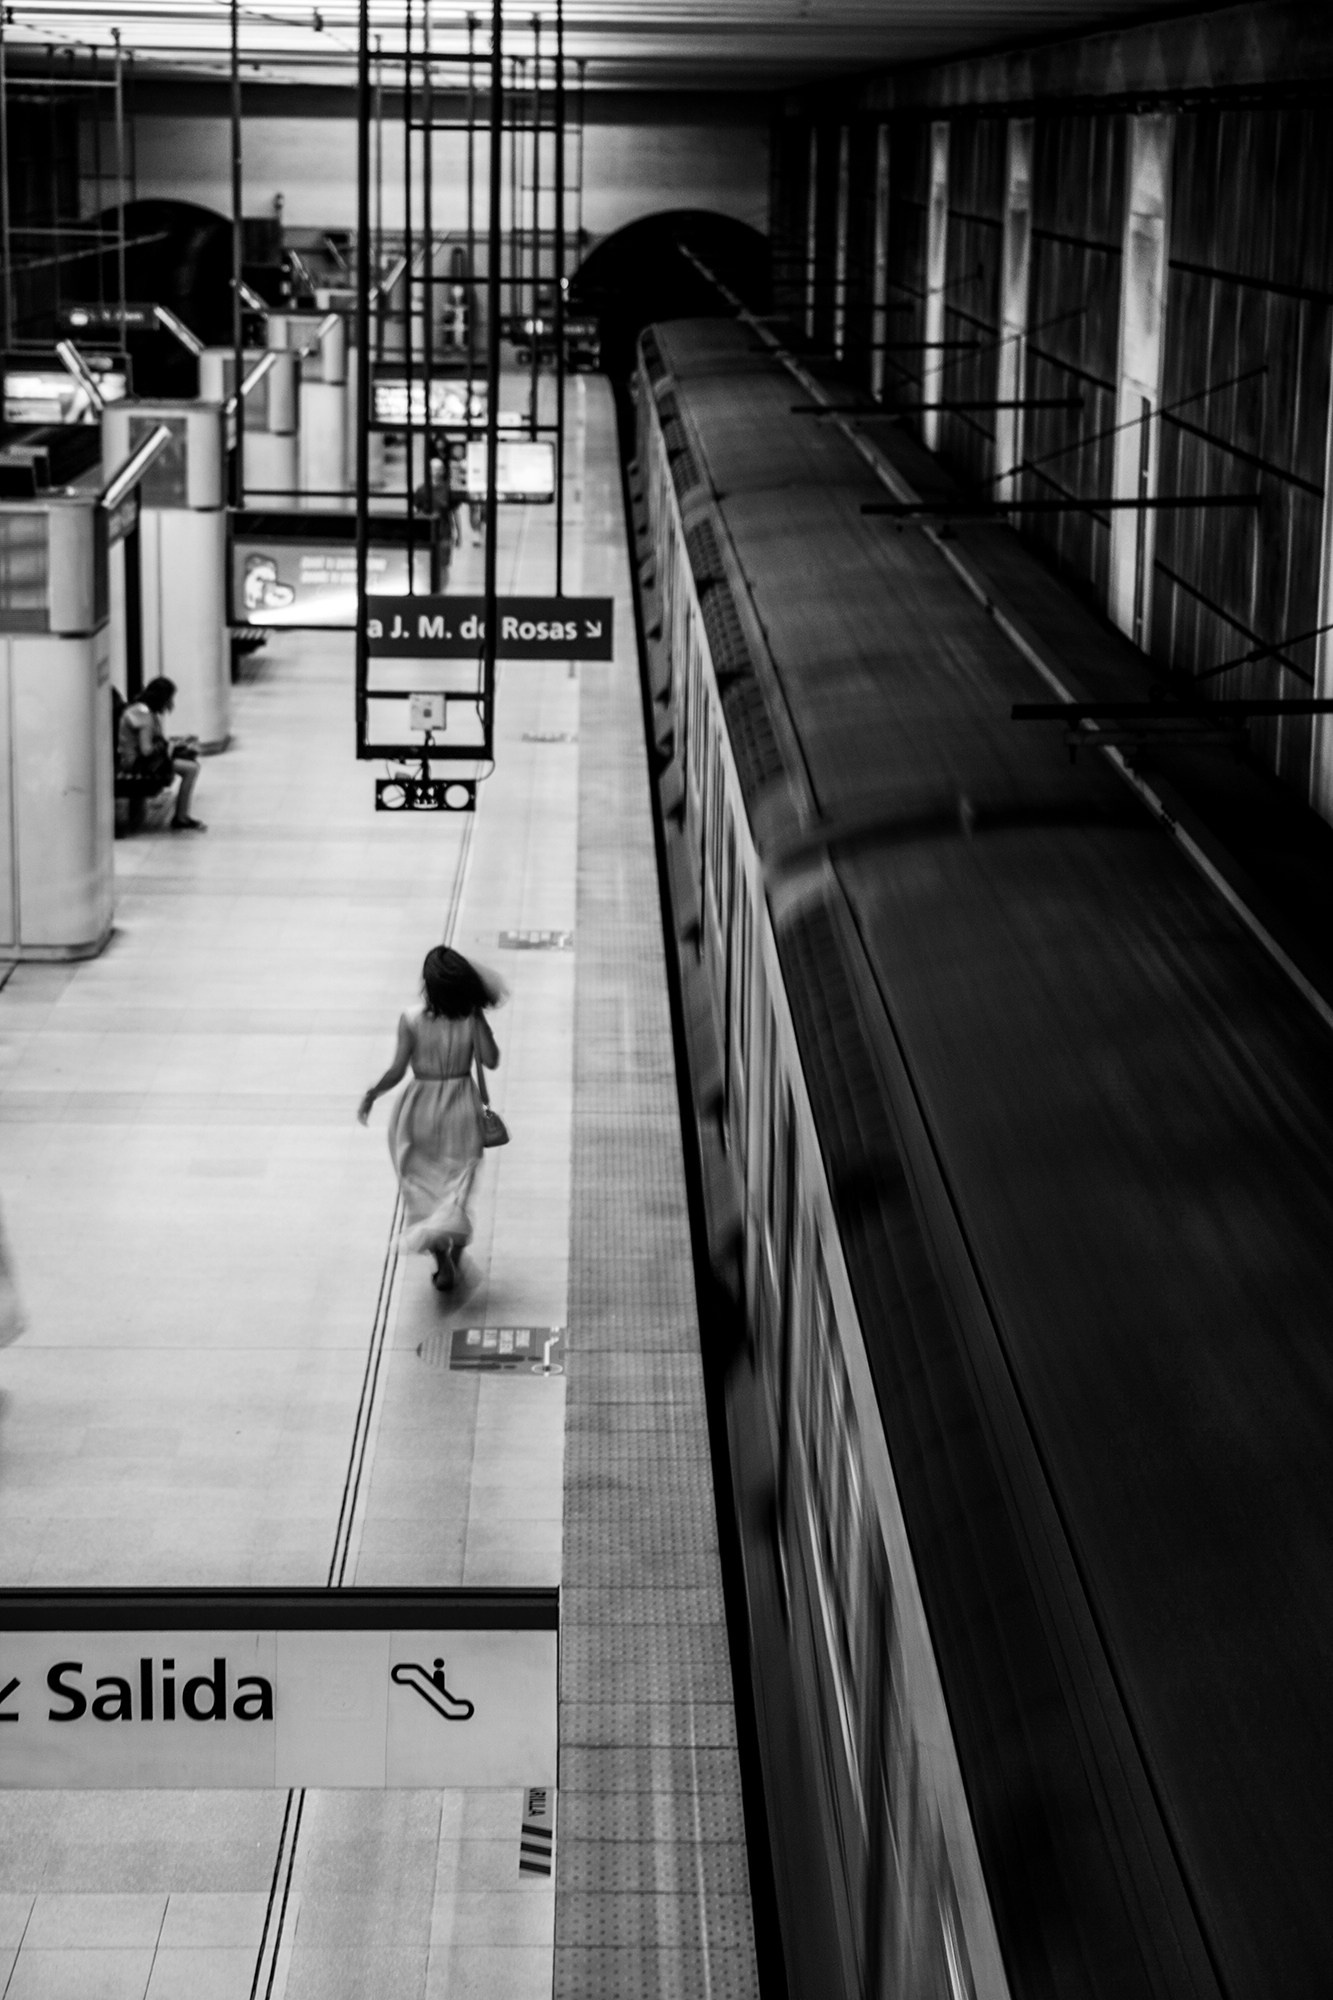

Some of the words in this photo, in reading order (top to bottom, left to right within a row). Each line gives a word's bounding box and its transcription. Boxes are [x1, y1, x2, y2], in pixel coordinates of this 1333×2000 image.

[367, 620, 383, 638] a
[390, 615, 409, 639] J.
[418, 615, 452, 639] M.
[502, 616, 577, 640] Rosas
[46, 1658, 274, 1722] Salida
